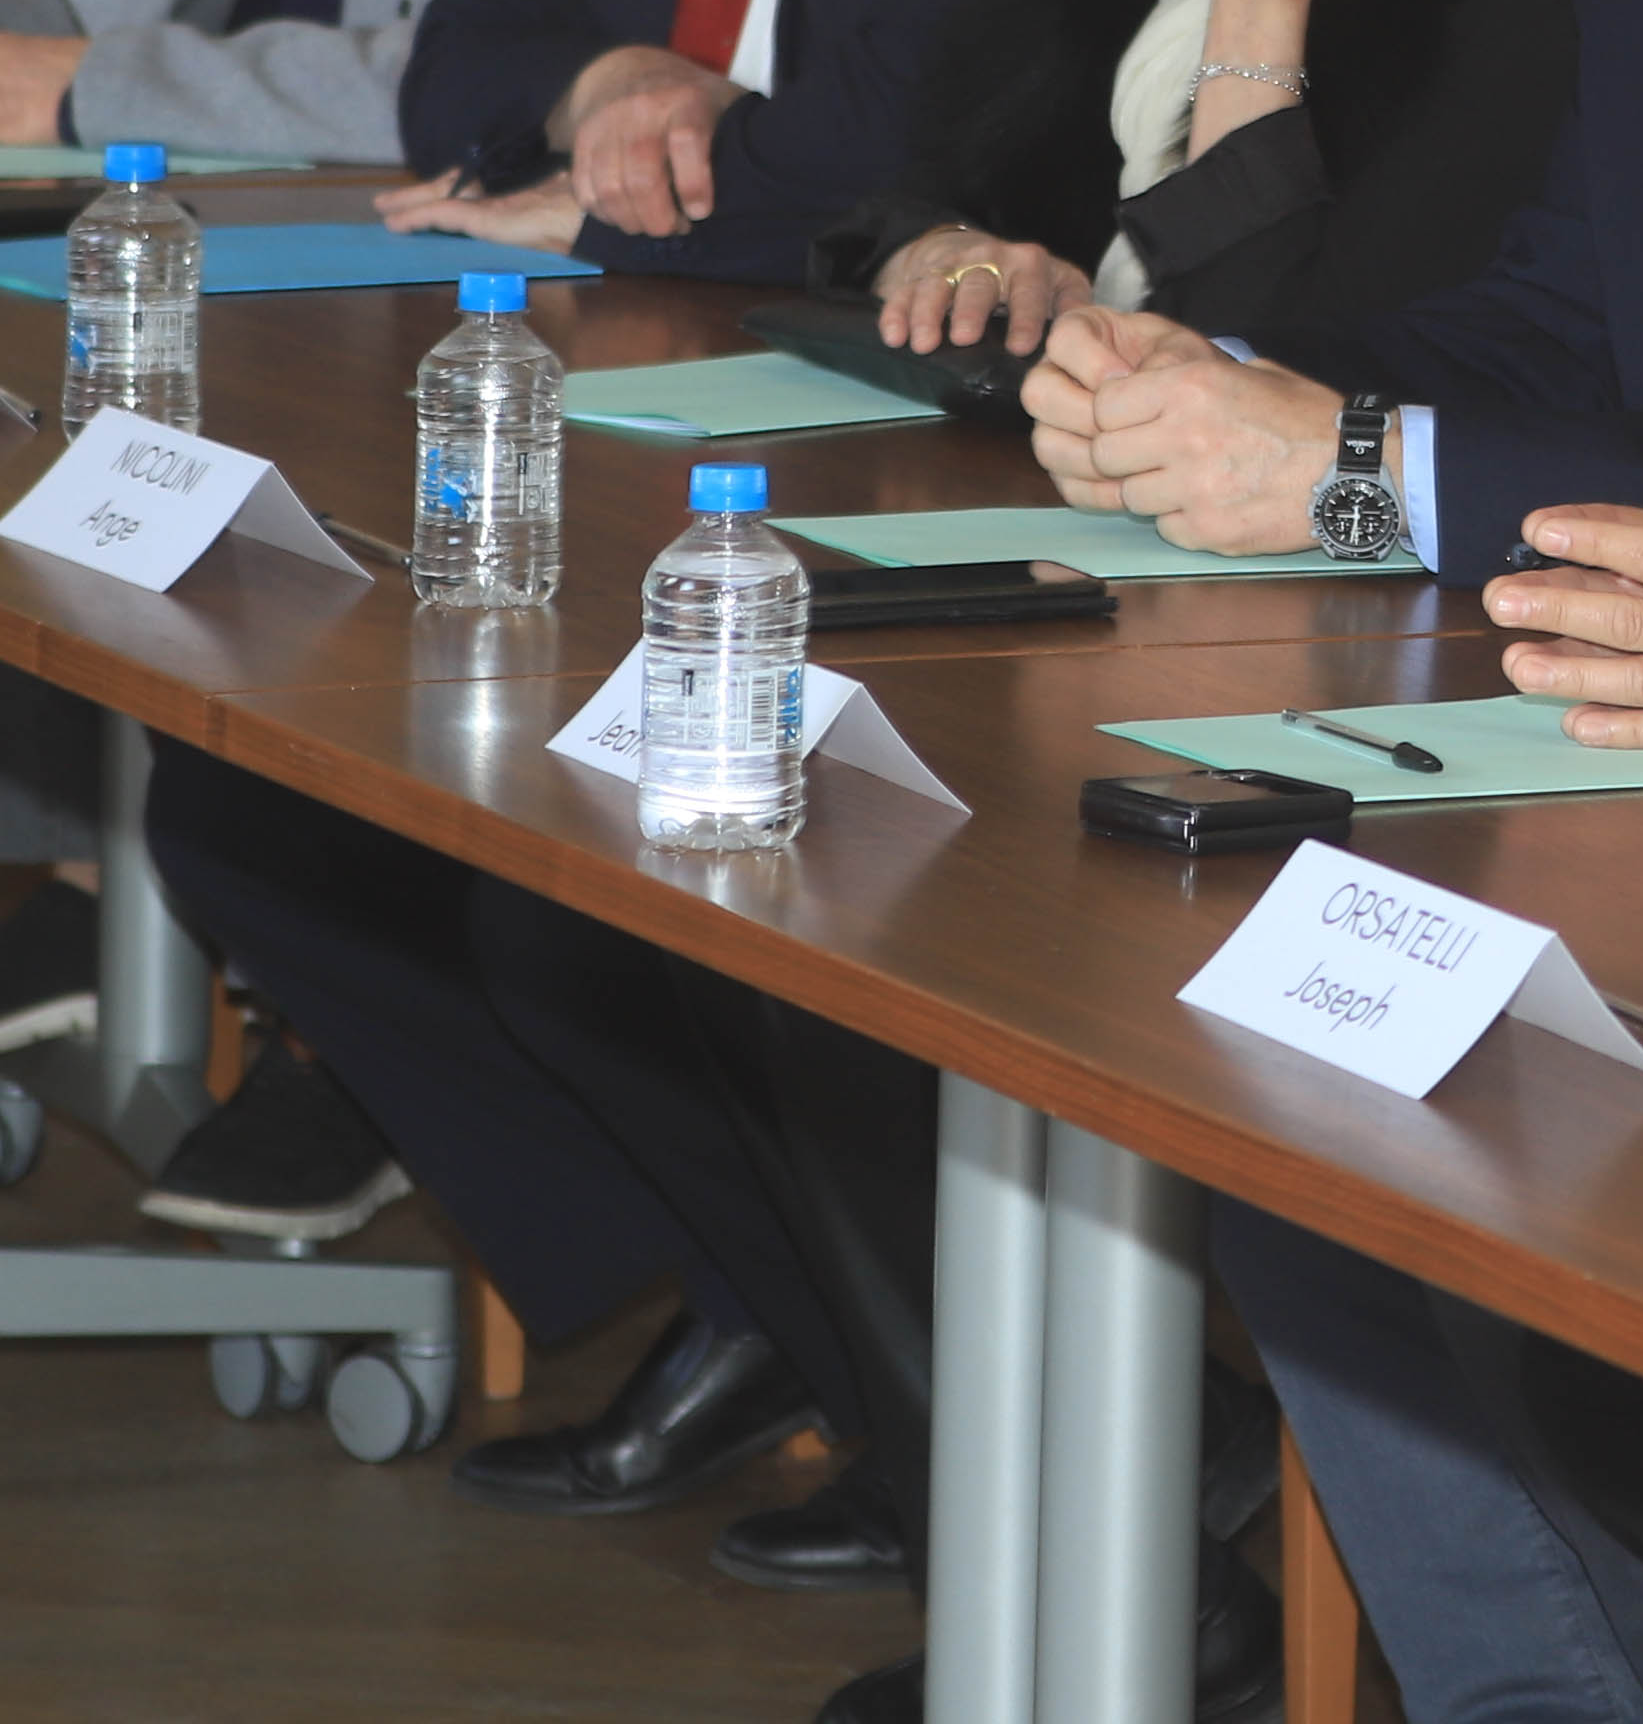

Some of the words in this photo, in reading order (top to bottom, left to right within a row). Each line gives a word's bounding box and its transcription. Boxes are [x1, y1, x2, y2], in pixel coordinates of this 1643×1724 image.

[110, 440, 212, 496] NICOLINI
[80, 500, 142, 547] Ange
[1322, 883, 1479, 973] ORSATELLI
[1284, 960, 1398, 1032] Joseph
